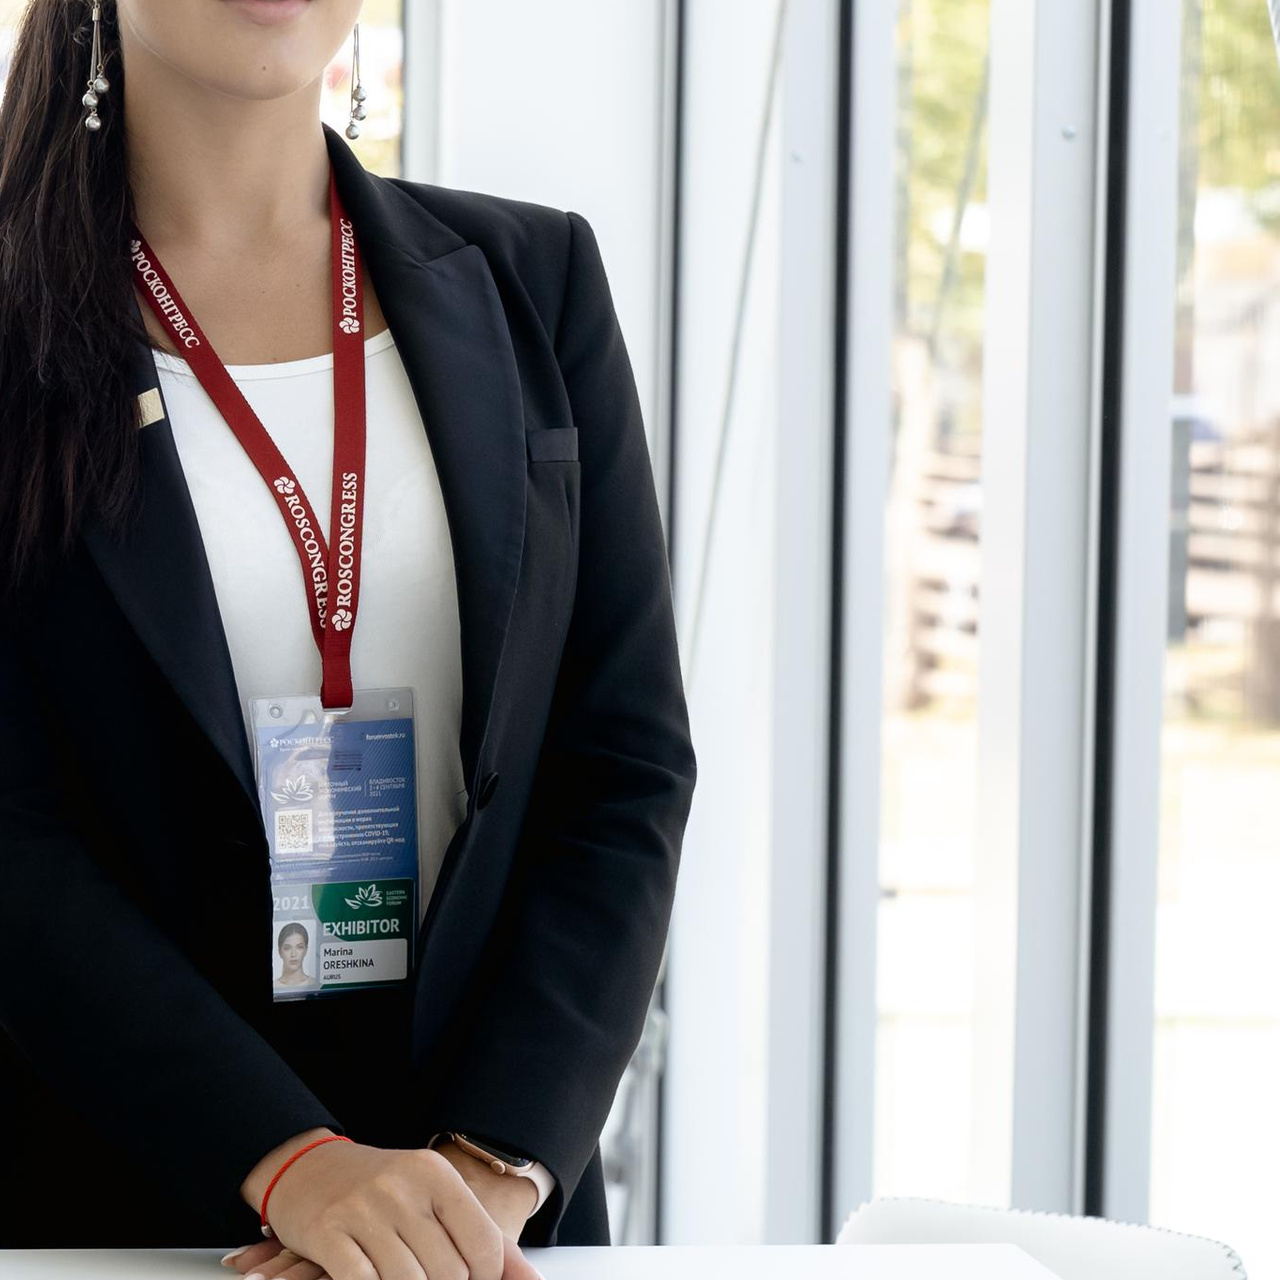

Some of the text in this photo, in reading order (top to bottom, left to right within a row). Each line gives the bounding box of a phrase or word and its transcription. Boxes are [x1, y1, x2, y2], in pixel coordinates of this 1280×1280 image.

[338, 218, 357, 317] РОСКОНГРЕСС
[131, 250, 200, 350] РОСКОНГРЕСС
[336, 472, 358, 607] ROSCONGRESS
[273, 895, 310, 911] 2021
[322, 918, 400, 937] EXHIBITOR
[323, 947, 353, 957] Marina
[323, 958, 375, 970] ORESHKINA
